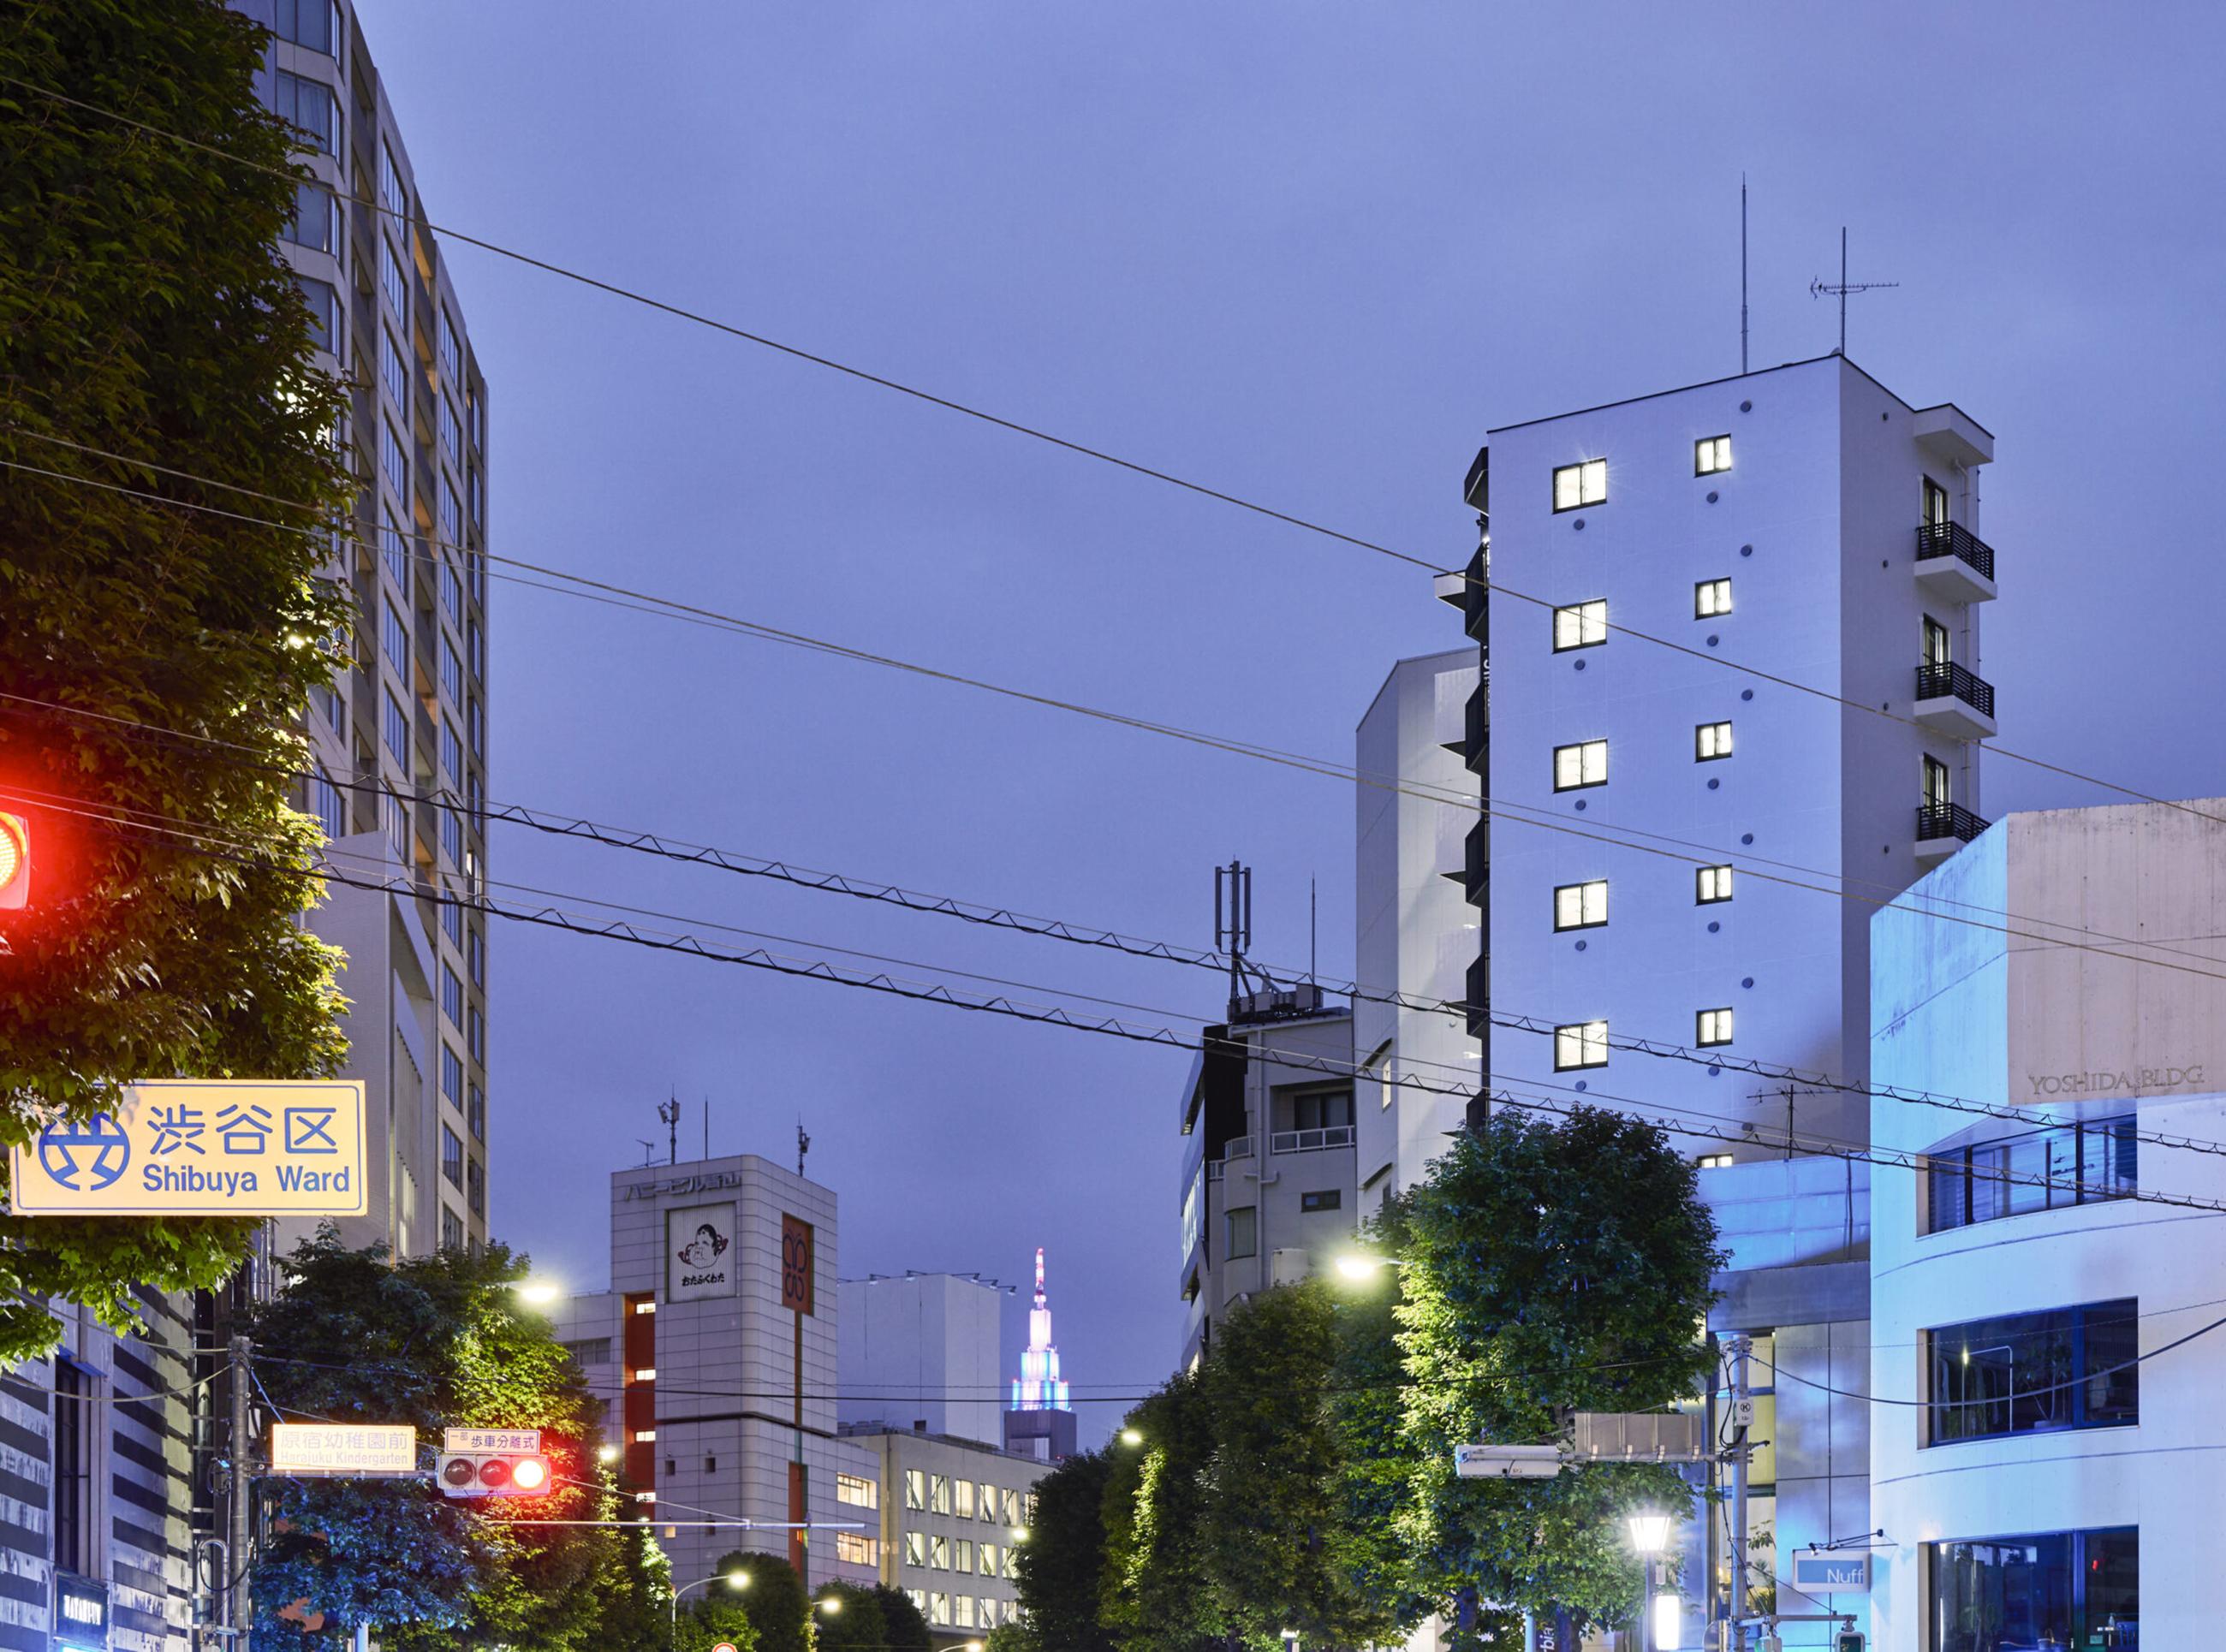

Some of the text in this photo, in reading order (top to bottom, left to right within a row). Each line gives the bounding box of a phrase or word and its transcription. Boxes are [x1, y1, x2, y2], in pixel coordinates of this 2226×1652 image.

[2028, 1072, 2131, 1095] YOSHIDA
[146, 1103, 338, 1156] 渋谷区
[142, 1163, 350, 1197] Shibuya Ward
[681, 1272, 725, 1287] おたふくわた
[281, 1431, 408, 1450] 原宿幼稚園前
[471, 1435, 535, 1450] 歩車分離式
[336, 1453, 408, 1466] Kindergarten
[1827, 1568, 1863, 1583] Nuff
